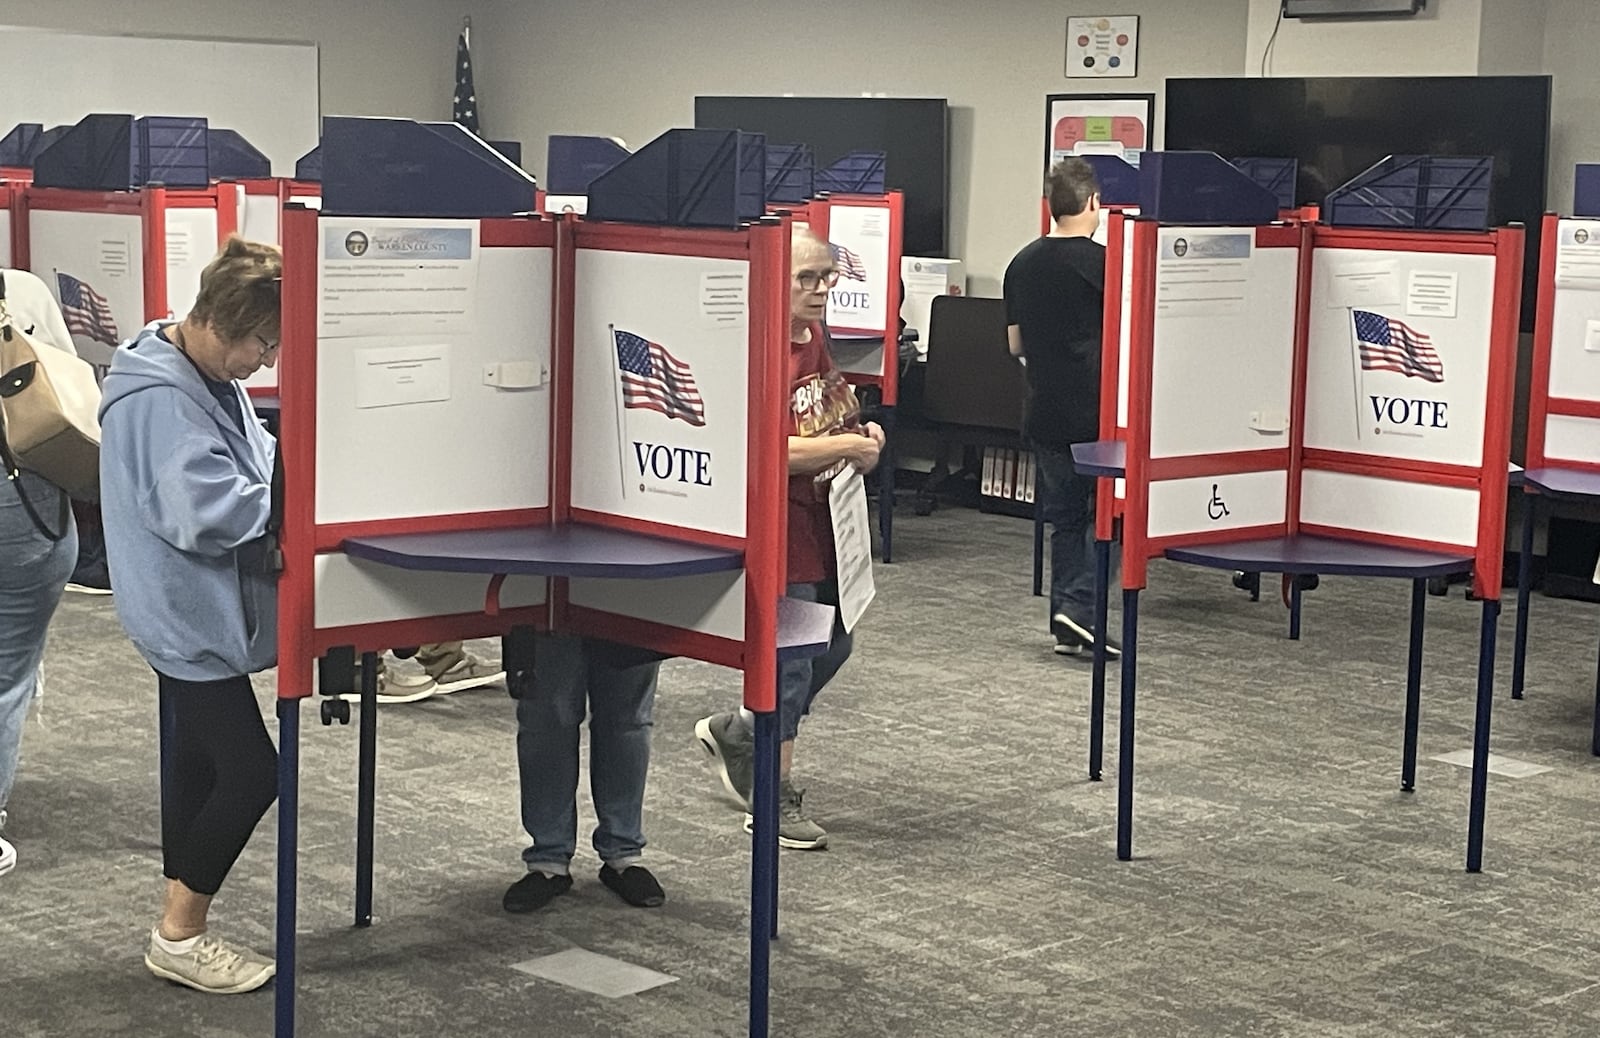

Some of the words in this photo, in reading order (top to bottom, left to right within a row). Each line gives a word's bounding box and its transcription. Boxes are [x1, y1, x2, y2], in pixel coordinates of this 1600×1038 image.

[831, 291, 870, 309] VOTE
[1369, 395, 1448, 429] VOTE
[633, 441, 712, 486] VOTE
